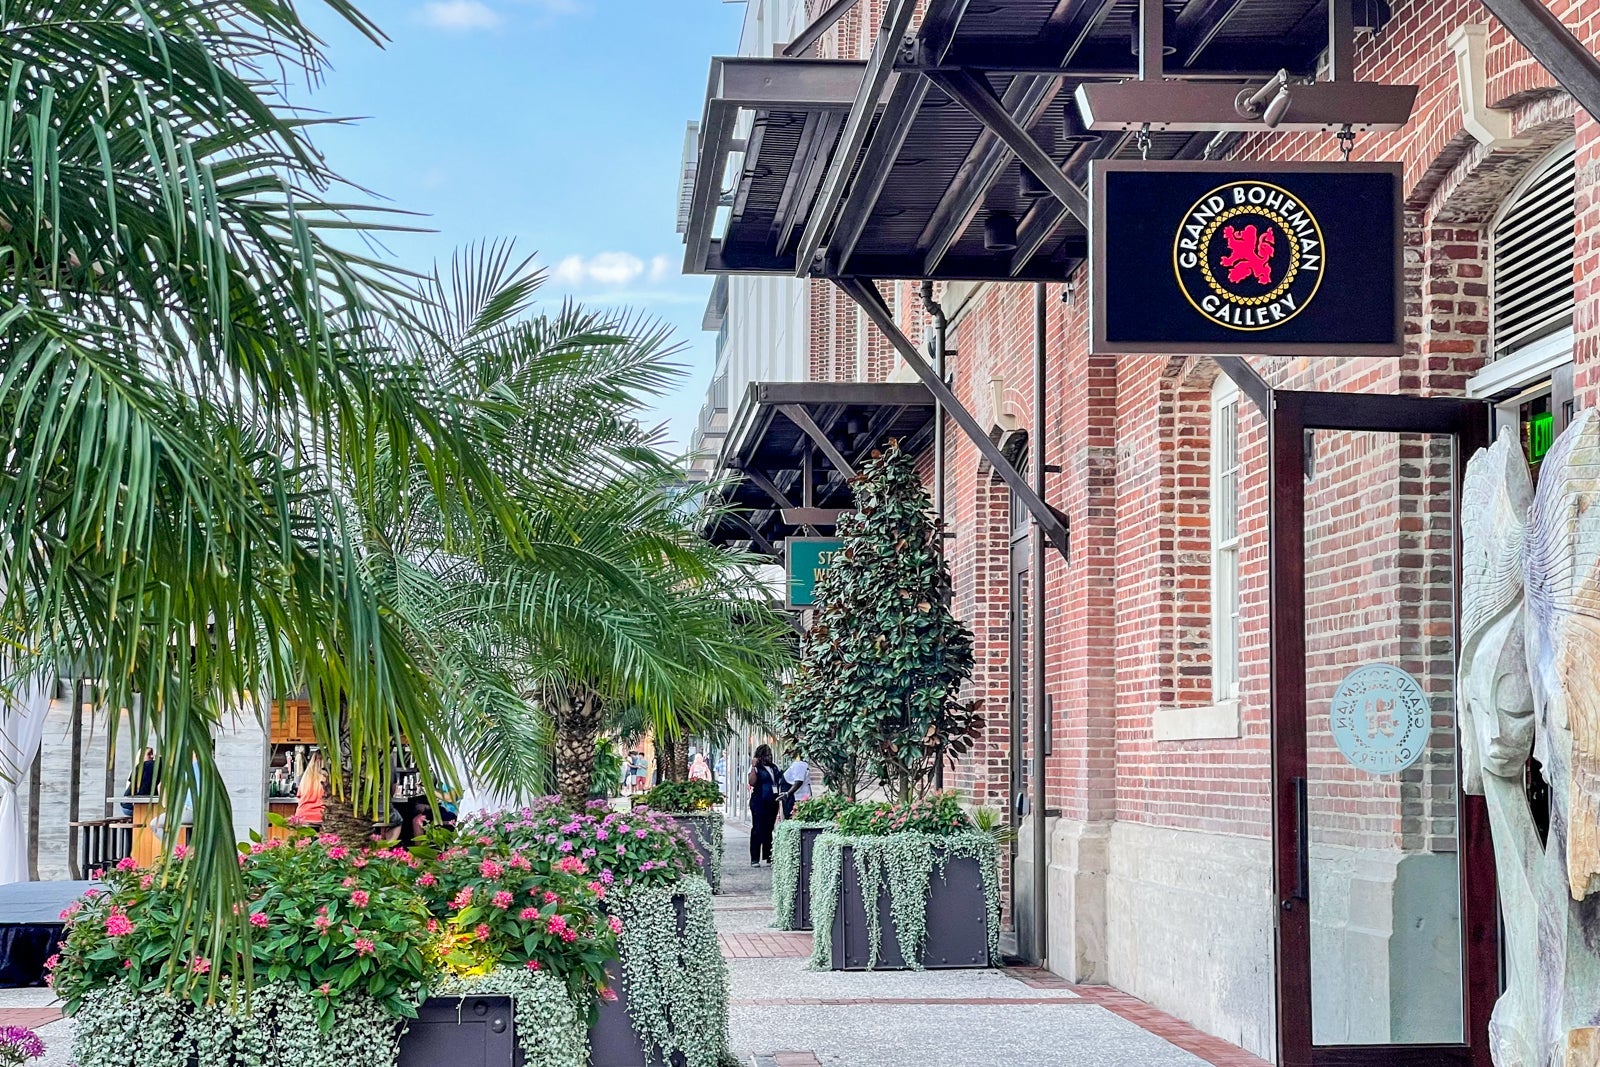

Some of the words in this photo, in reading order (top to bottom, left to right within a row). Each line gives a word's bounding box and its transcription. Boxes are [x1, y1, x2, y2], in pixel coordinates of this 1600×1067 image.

[1180, 195, 1225, 268] GRAND
[1233, 187, 1321, 271] BOHEMIAN
[1202, 293, 1297, 325] GALLERY
